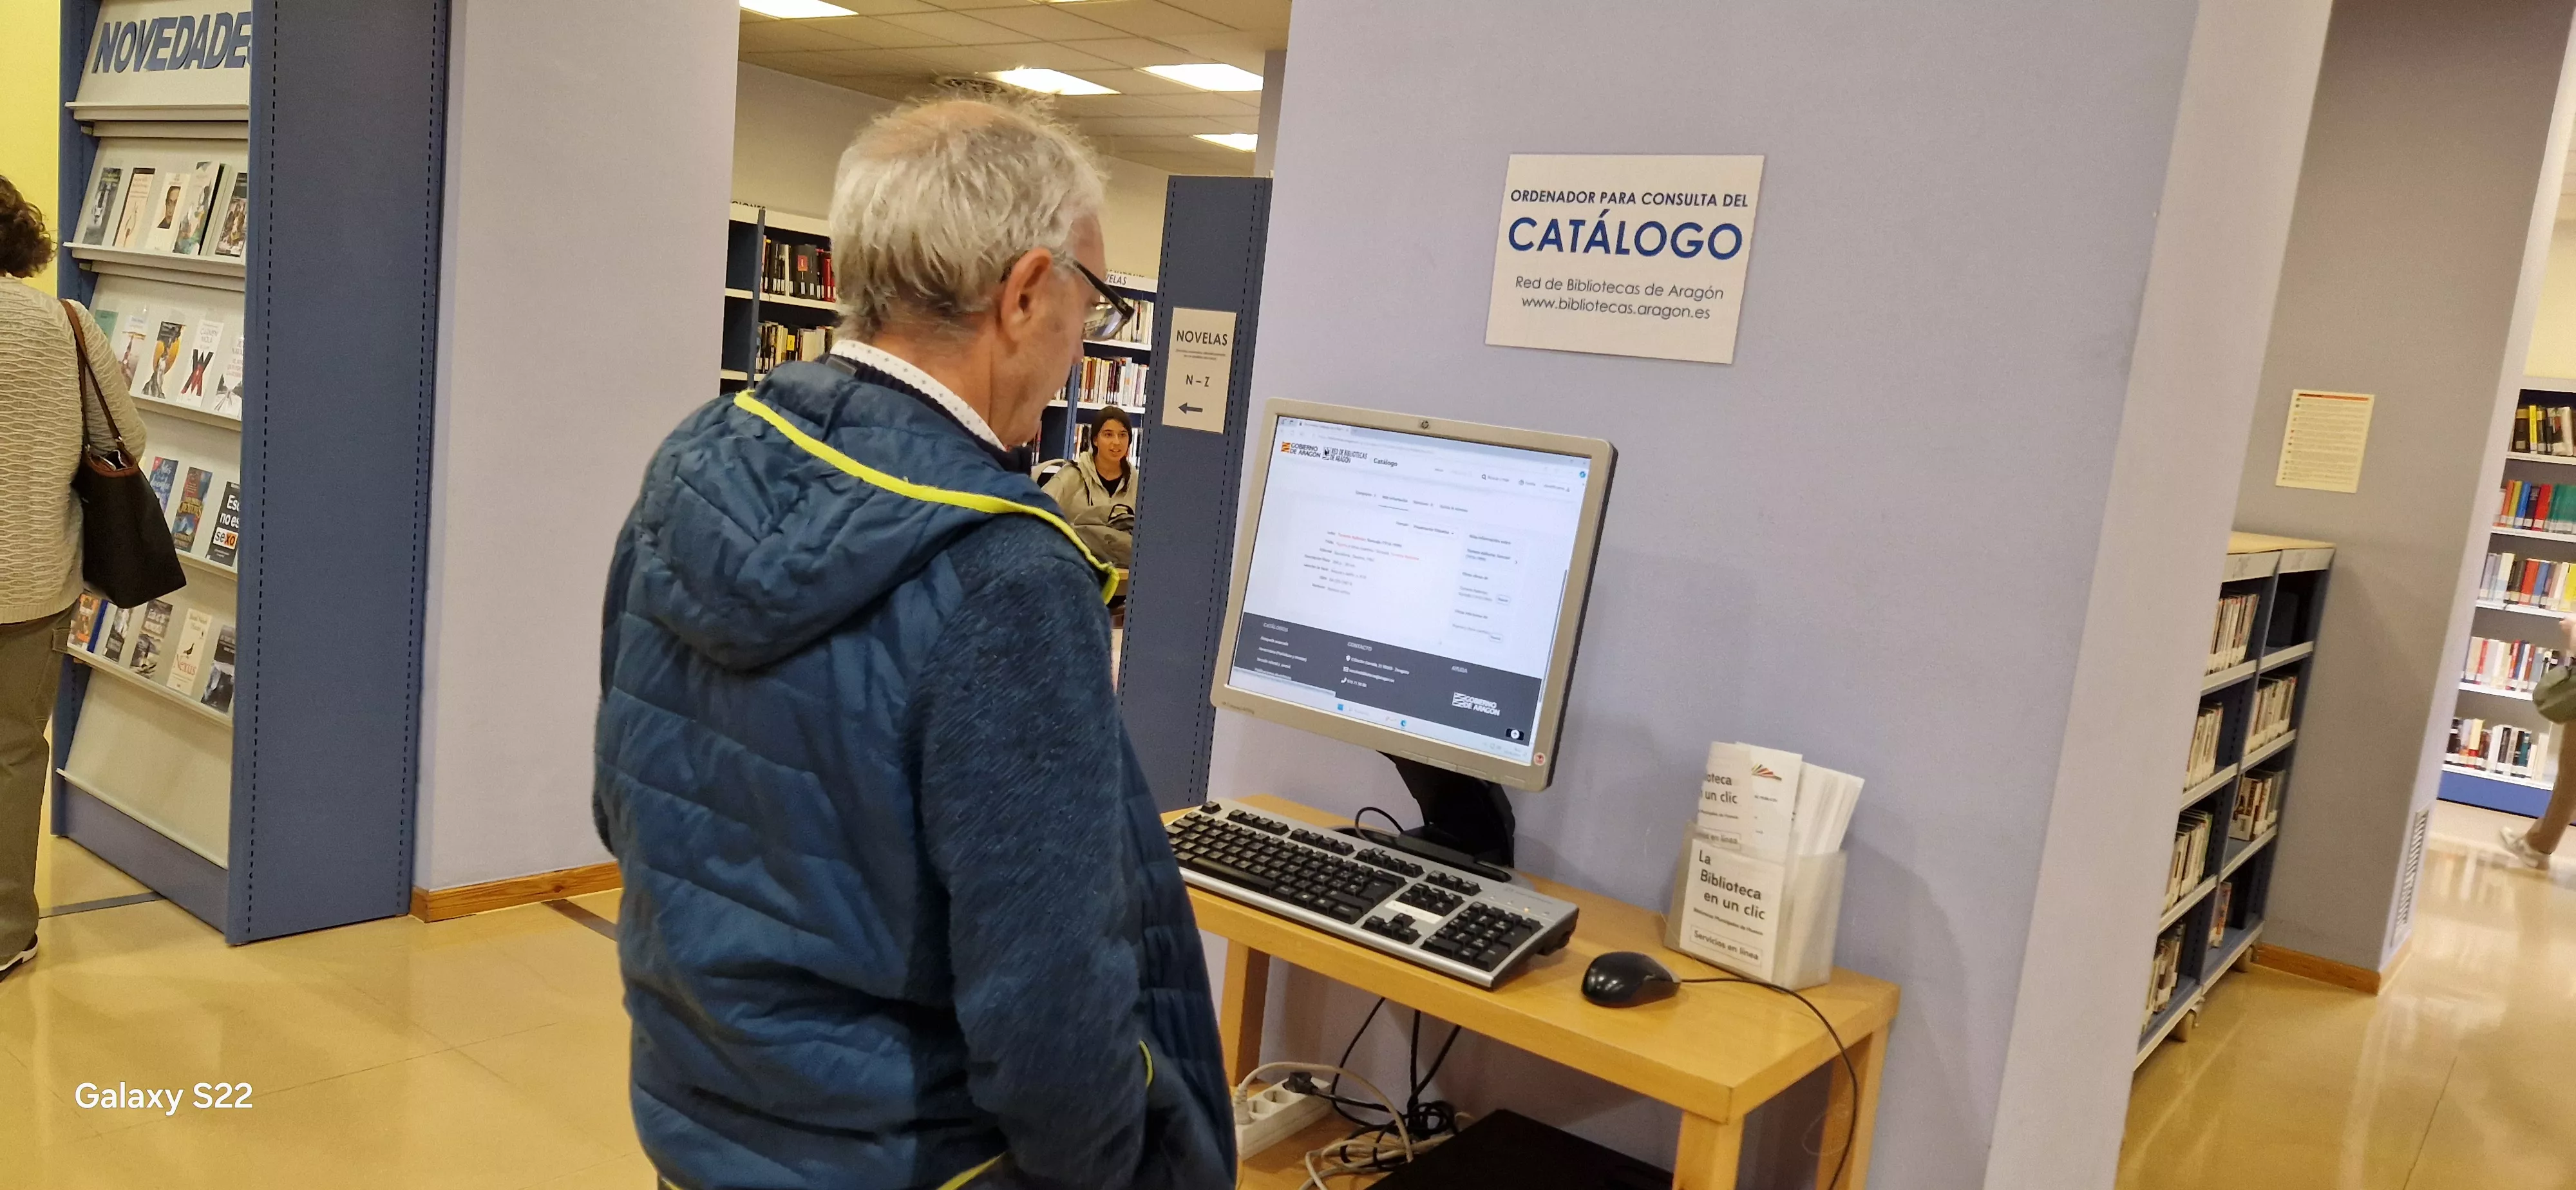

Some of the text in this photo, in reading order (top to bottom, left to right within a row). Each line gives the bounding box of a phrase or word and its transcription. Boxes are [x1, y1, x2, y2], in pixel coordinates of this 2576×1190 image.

[91, 12, 251, 73] NOVEDADE
[1511, 190, 1748, 207] ORDENADOR PARA CONSULTA DEL
[1508, 209, 1743, 260] CATÁLOGO
[1515, 276, 1724, 301] Red de Bibliotecas de Aragón
[1522, 297, 1710, 320] www.bibliotecas.aragon.es
[1176, 330, 1227, 346] NOVELAS
[1186, 374, 1193, 385] N
[1204, 376, 1211, 387] Z
[1291, 442, 1318, 451] GOBIERNO
[1373, 458, 1398, 468] Catálogo
[220, 513, 231, 525] no
[214, 531, 236, 546] sexo
[1465, 696, 1497, 708] GOBIERNO
[1705, 791, 1738, 804] un clic
[1699, 849, 1711, 865] La
[1700, 869, 1762, 900] Biblioteca
[1704, 892, 1765, 920] en un clic
[1694, 930, 1726, 949] Servicios
[1727, 944, 1737, 953] en
